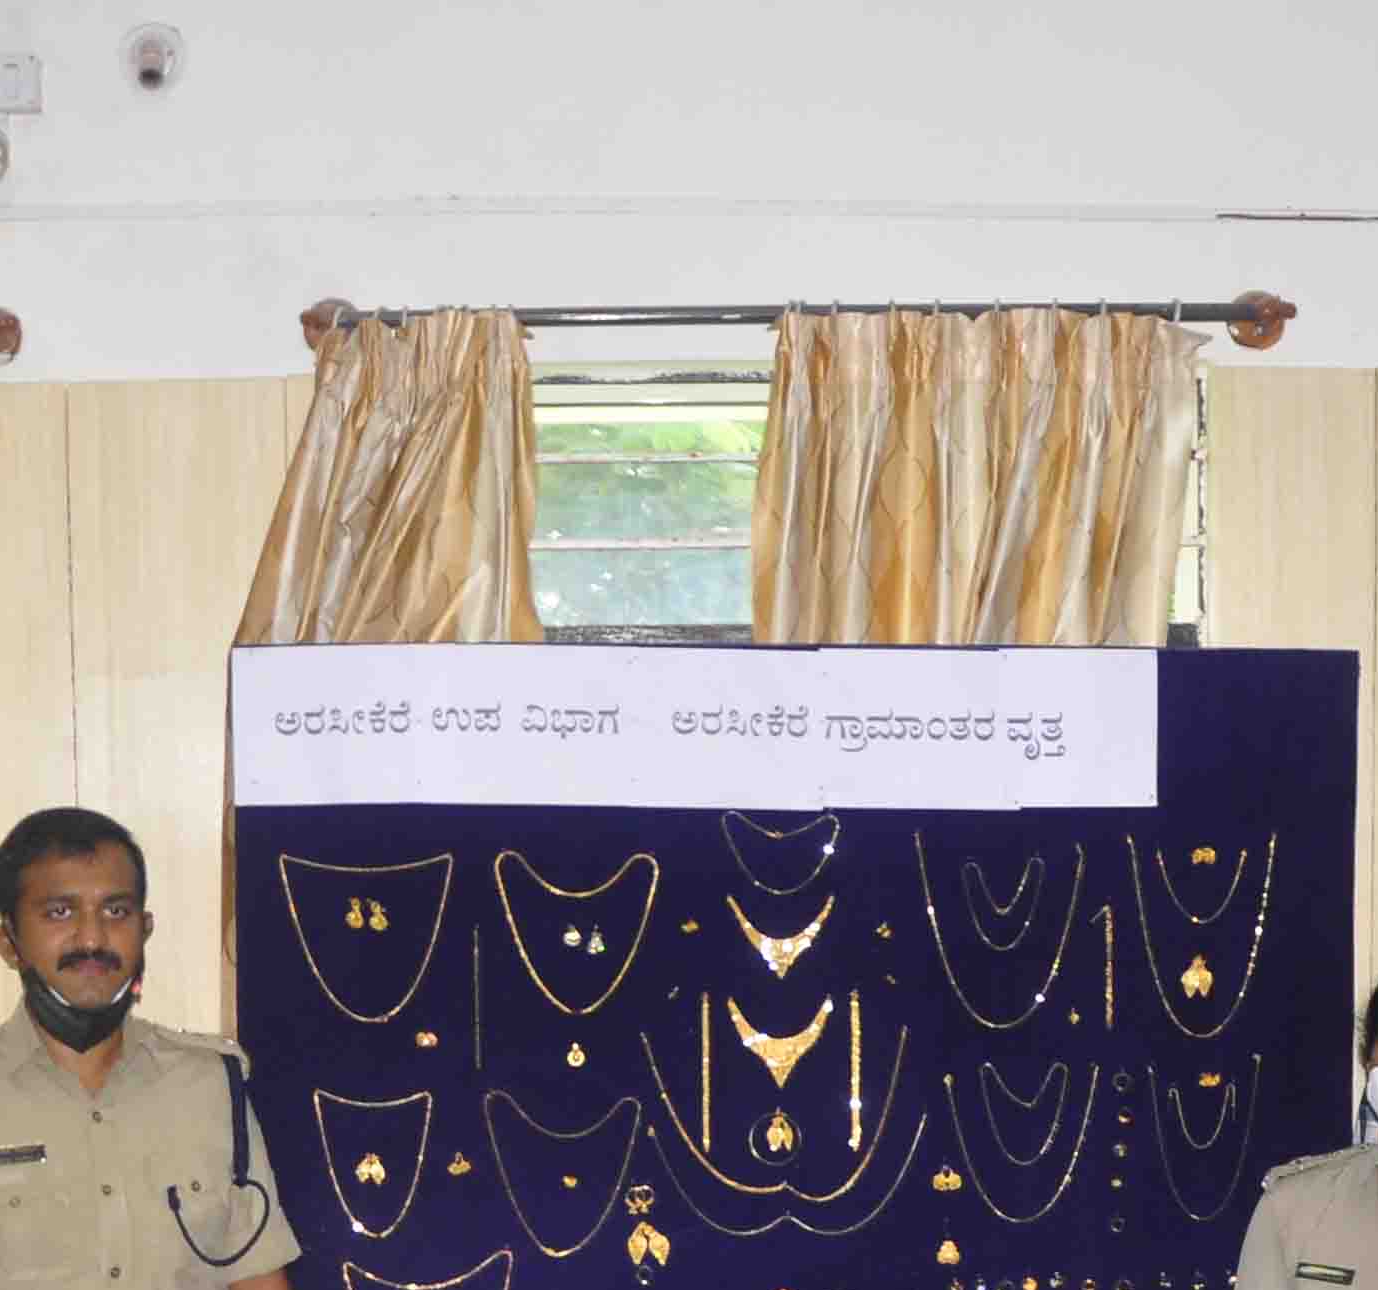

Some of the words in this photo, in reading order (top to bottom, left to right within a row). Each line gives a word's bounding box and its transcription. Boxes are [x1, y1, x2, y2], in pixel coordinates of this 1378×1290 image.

[274, 700, 411, 737] ಅರಸೀಕೆರೆ
[431, 703, 502, 732] ಉಪ
[520, 703, 620, 740] ವಿಭಾಗ
[670, 704, 810, 739] ಅರಸೀಕೆರೆ
[823, 711, 997, 753] ಗ್ರಾಮಾಂತರ
[1006, 711, 1067, 761] ವೃತ್ತ
